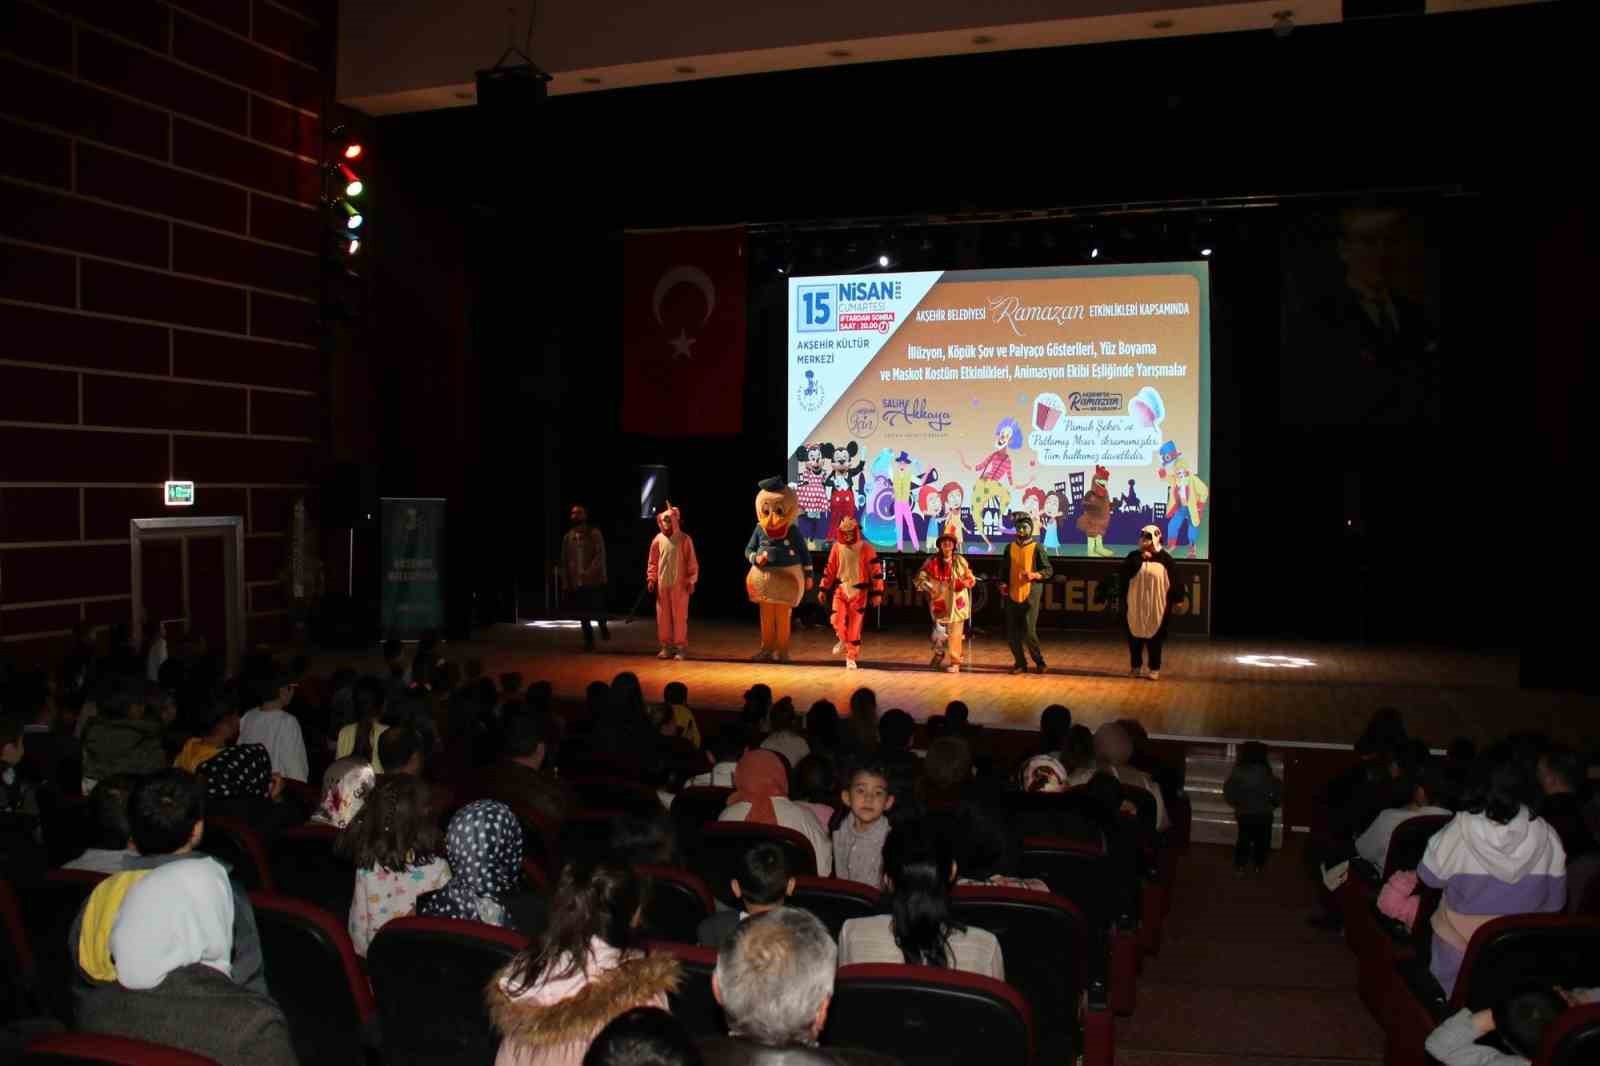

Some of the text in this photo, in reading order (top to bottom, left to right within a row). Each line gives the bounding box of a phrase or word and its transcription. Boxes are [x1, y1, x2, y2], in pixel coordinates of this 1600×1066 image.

[802, 292, 830, 325] 15
[987, 296, 1085, 336] Ramazan
[1139, 302, 1190, 315] KAPSAMINDA
[837, 338, 870, 348] KÜLTÜR
[948, 345, 977, 360] Köpük
[996, 347, 1008, 357] ve
[1009, 343, 1044, 358] Palyaço
[1046, 341, 1097, 358] Gösterileri,
[1100, 341, 1117, 355] Yüz
[1118, 341, 1157, 357] Boyama
[797, 353, 834, 364] MERKEZİ
[880, 371, 891, 381] ve
[892, 369, 922, 381] Maskot
[925, 368, 959, 380] Kostüm
[1014, 365, 1065, 380] Animasyon
[1067, 364, 1089, 377] Ekibi
